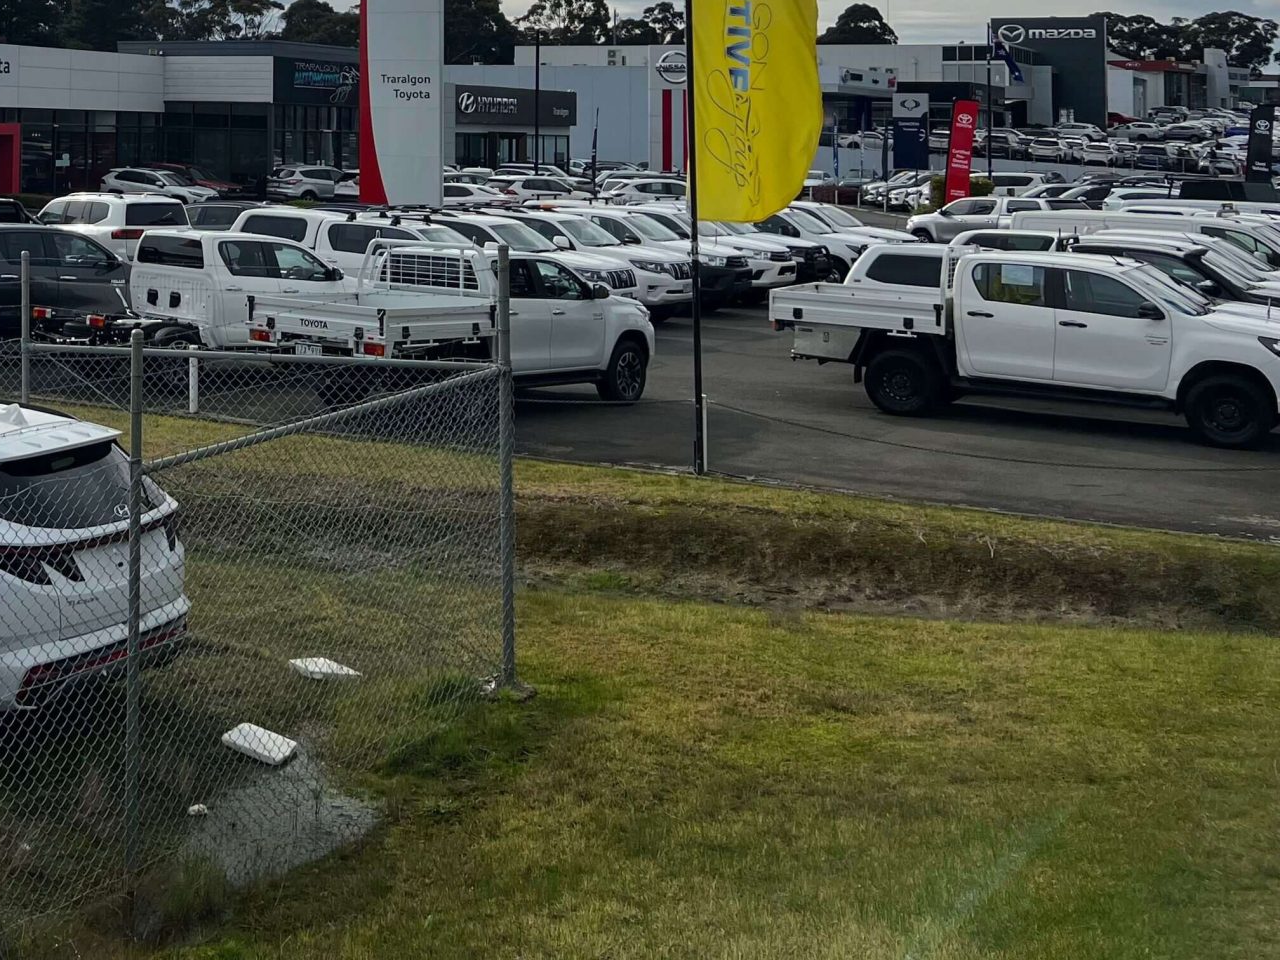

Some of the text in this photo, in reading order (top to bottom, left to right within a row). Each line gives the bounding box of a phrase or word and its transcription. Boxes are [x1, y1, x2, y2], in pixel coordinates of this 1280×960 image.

[1028, 28, 1097, 39] mazda
[294, 62, 340, 73] TRARALGON
[381, 74, 431, 86] Traralgon
[393, 89, 431, 101] Toyota
[477, 96, 518, 114] HYUNDAI
[299, 318, 329, 330] TOYOTA
